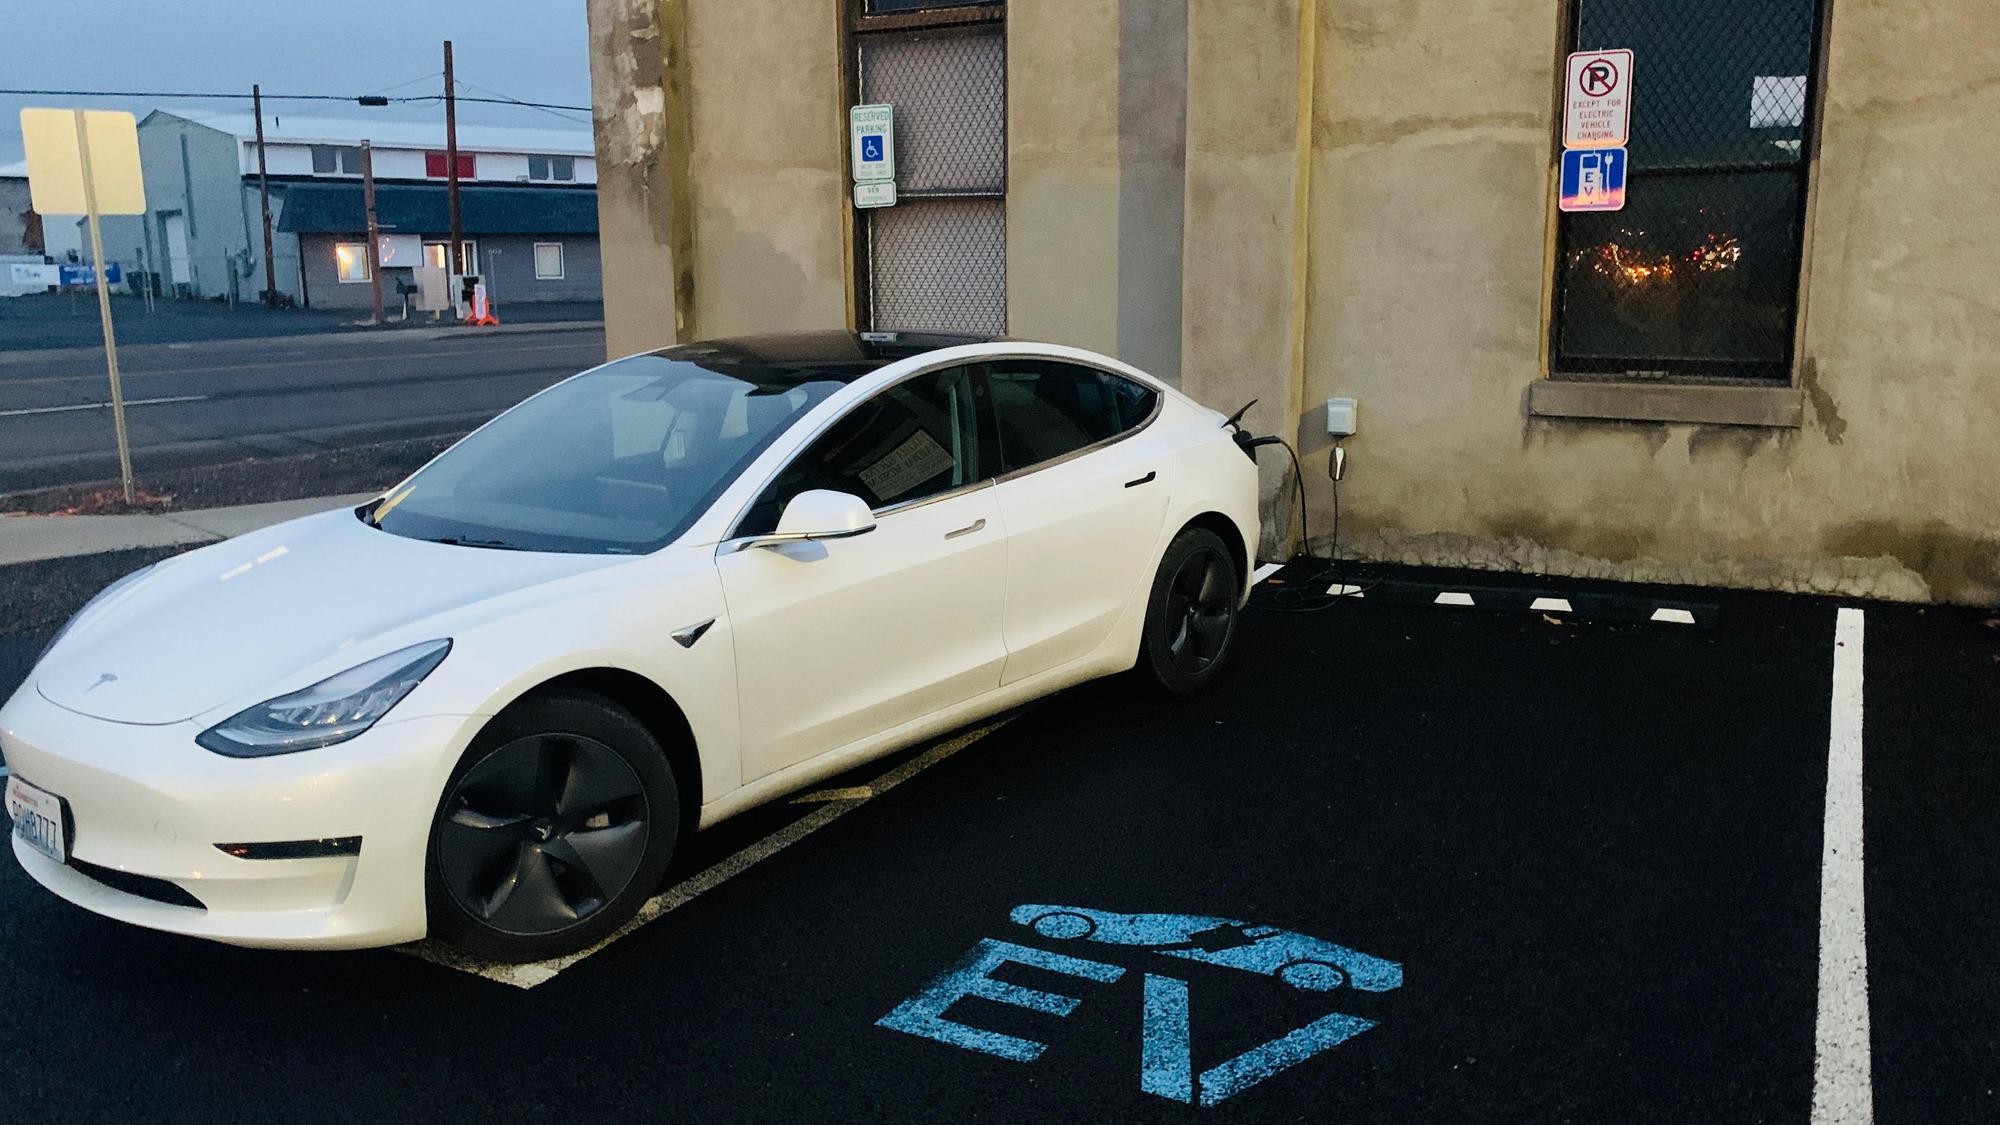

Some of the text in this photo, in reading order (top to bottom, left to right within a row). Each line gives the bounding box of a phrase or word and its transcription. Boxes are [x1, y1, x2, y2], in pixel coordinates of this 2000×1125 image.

[1573, 100, 1621, 110] EXCEPT FOR
[854, 111, 889, 122] RESERVED
[1579, 110, 1614, 119] ELECTRIC
[856, 124, 887, 134] PARKING
[1580, 120, 1611, 129] VEHICLE
[1577, 131, 1614, 140] CHARGING
[874, 938, 1380, 1107] EV
